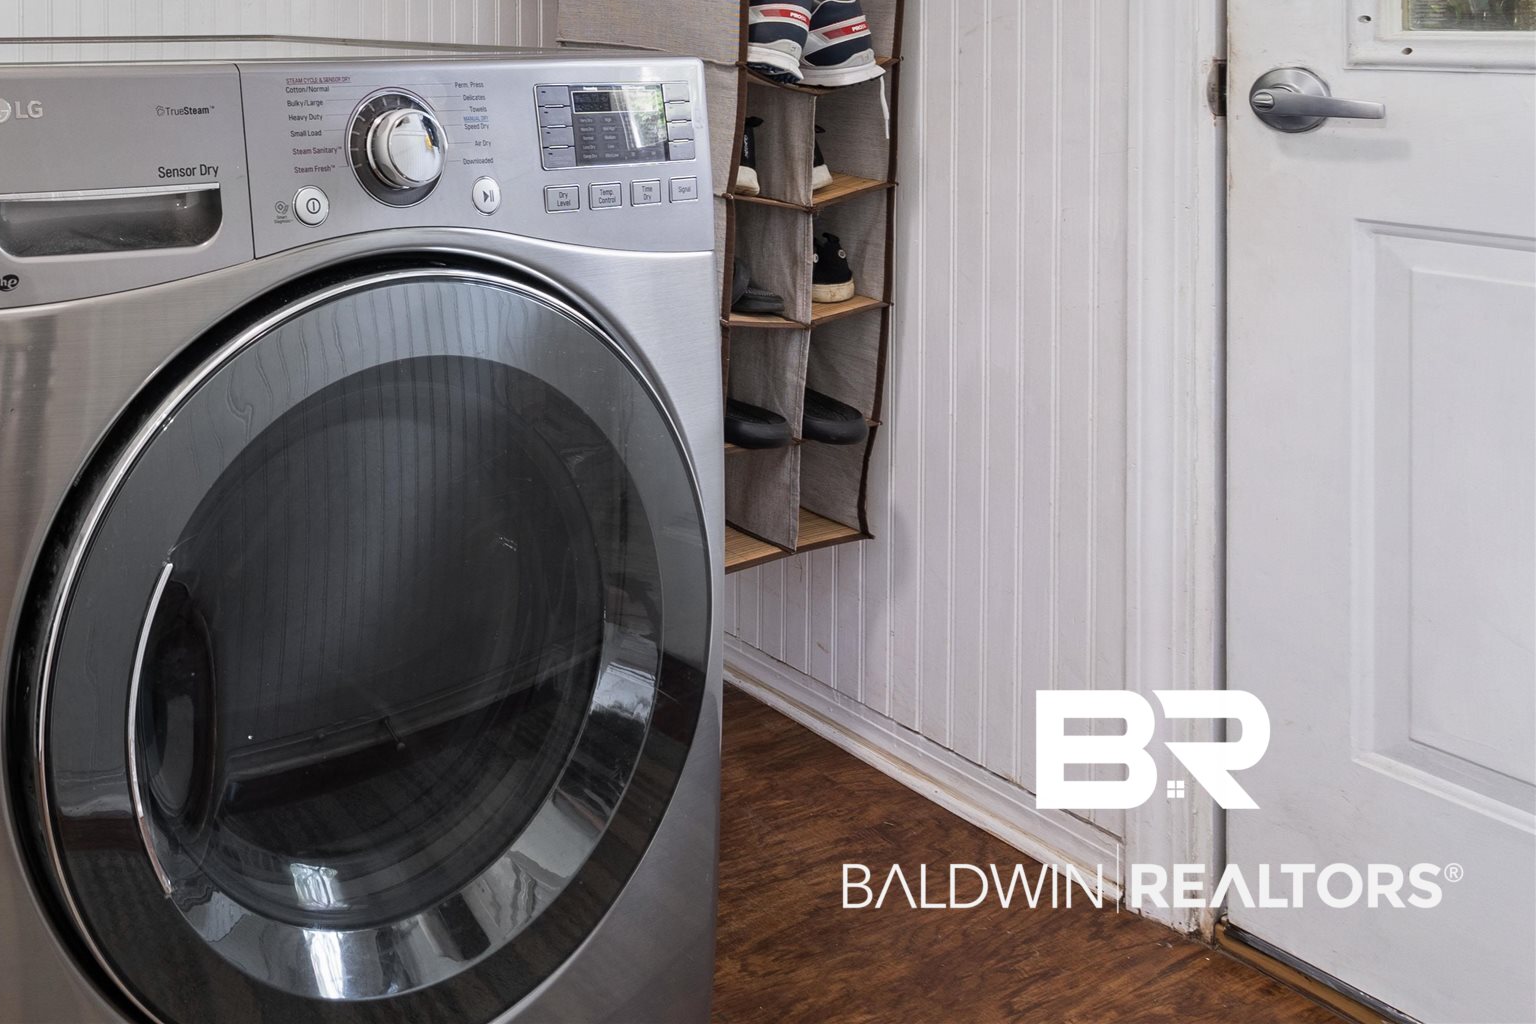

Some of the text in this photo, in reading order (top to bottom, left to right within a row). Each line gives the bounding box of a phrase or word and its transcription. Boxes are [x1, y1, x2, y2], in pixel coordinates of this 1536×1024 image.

[287, 99, 324, 107] Bulky/Large
[14, 100, 44, 120] LG
[463, 157, 494, 165] Downloaded
[158, 164, 219, 179] Sensor Dry
[556, 199, 571, 207] Level
[598, 196, 616, 204] Control
